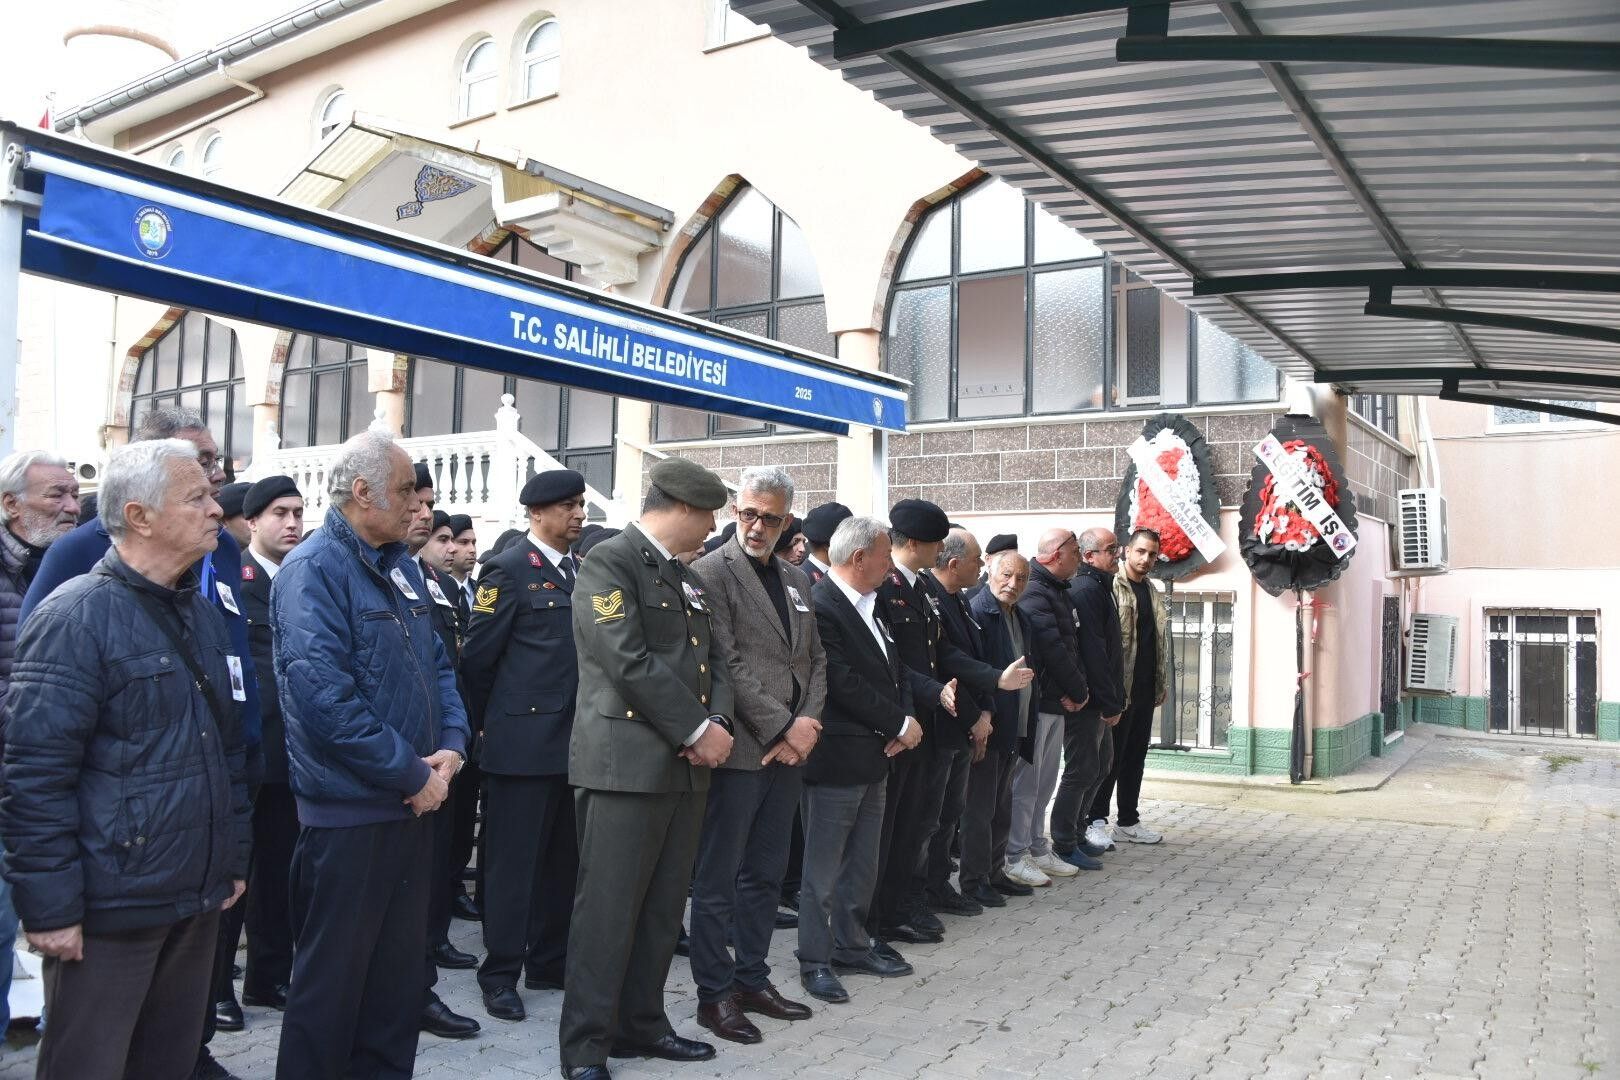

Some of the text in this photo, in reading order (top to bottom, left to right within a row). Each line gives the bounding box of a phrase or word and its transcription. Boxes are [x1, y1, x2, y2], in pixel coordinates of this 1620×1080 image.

[510, 311, 548, 346] T.C.
[553, 323, 629, 365] SALİHLİ
[631, 342, 728, 387] BELEDİYESİ
[795, 386, 812, 401] 2025
[1319, 512, 1339, 536] İŞ
